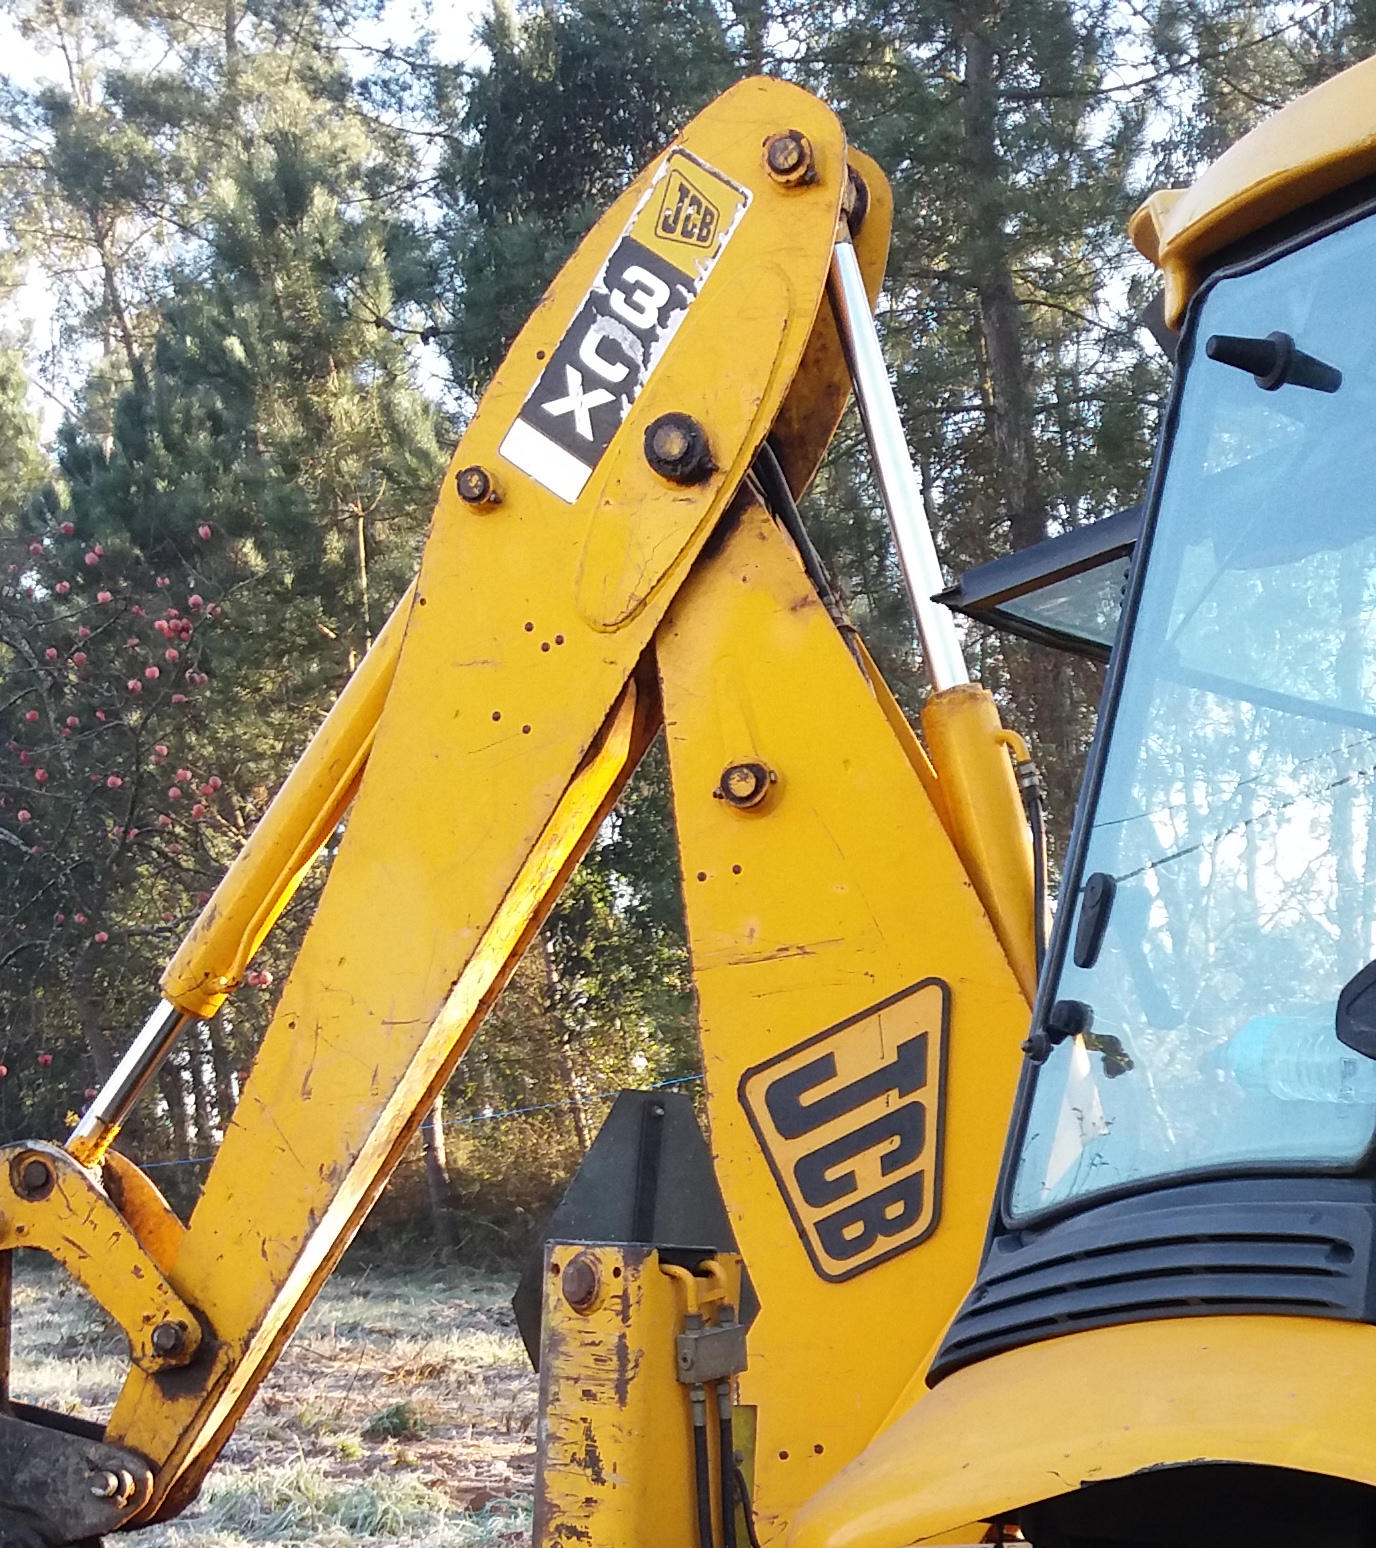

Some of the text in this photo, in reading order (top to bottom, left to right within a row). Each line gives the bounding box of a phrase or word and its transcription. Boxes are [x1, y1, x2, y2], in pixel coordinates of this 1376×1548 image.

[661, 182, 719, 244] JCB
[541, 264, 671, 442] 3CX
[764, 1031, 928, 1261] JCB
